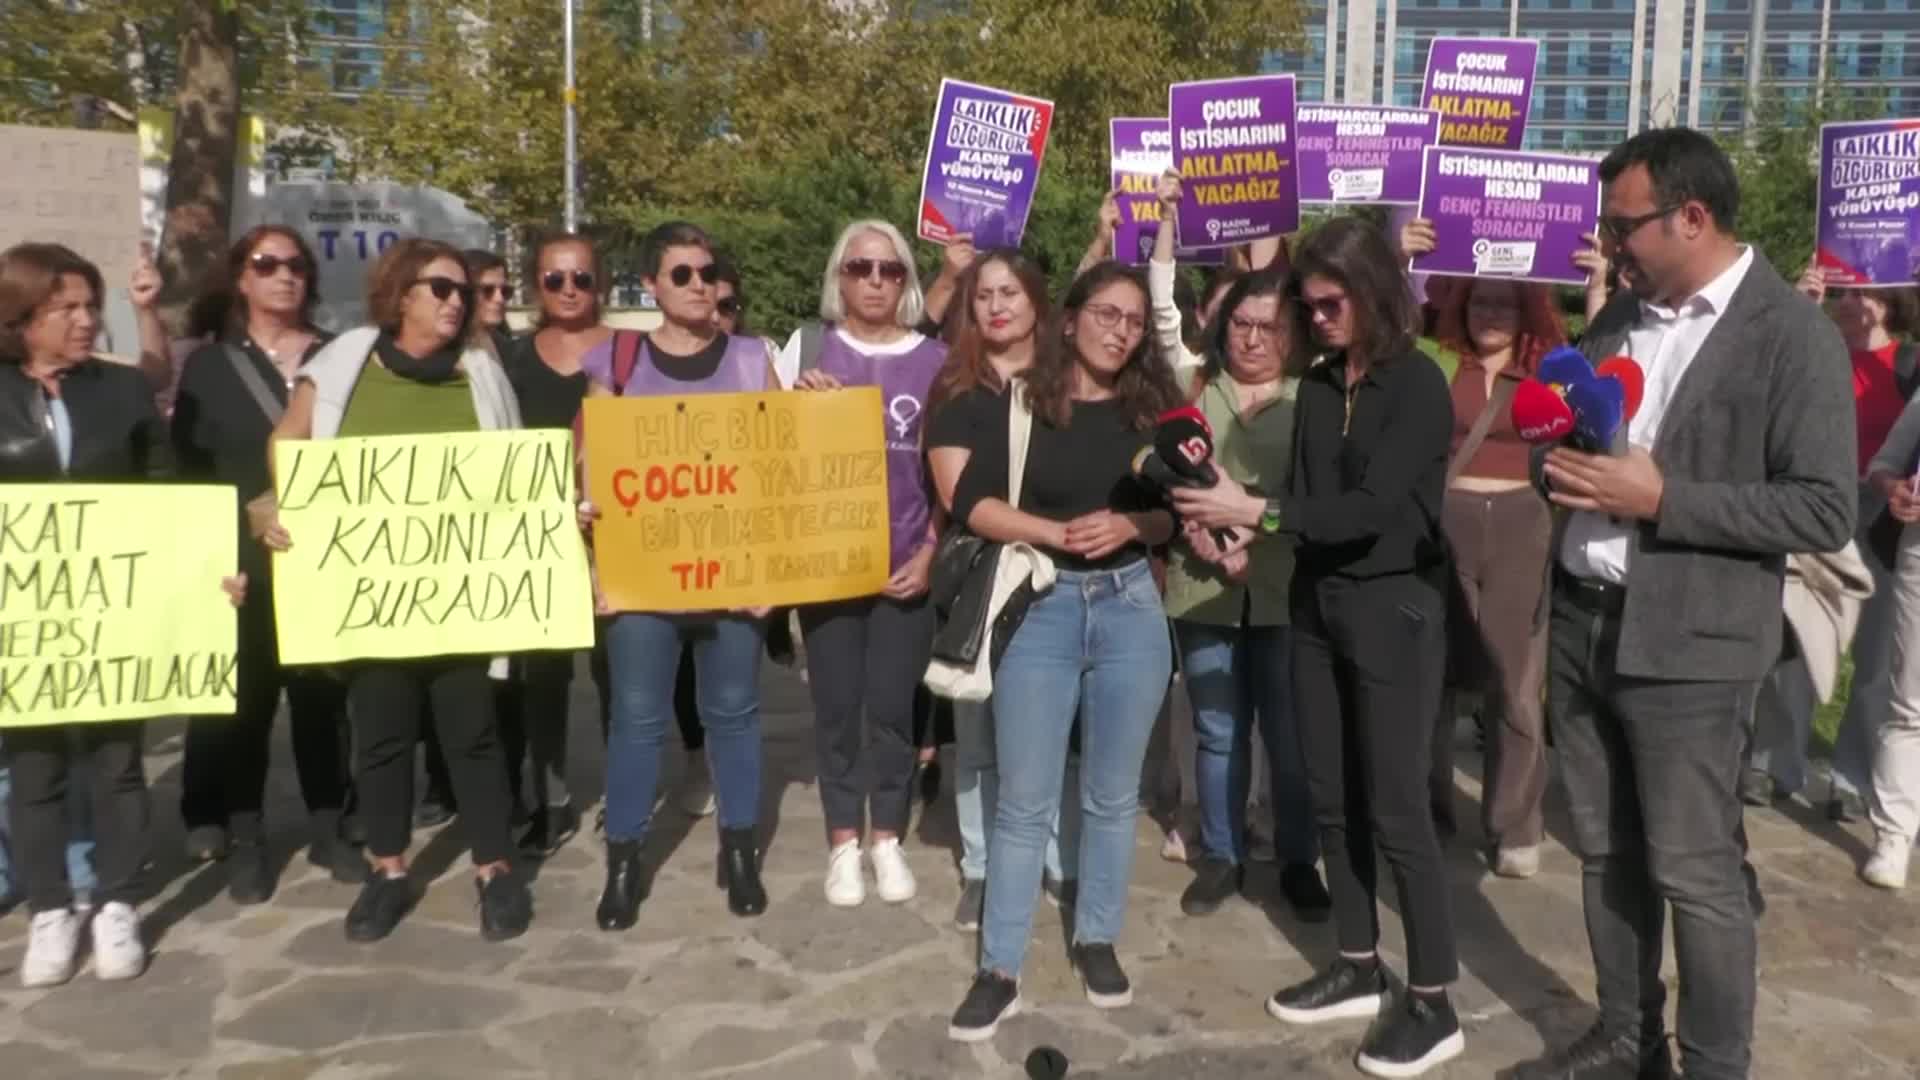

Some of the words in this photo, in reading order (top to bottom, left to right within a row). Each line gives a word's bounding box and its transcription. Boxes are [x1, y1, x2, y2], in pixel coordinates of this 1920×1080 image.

[1456, 53, 1508, 71] ÇOCUK
[1432, 70, 1524, 96] İSTİSMARINI
[1202, 97, 1261, 123] ÇOCUK
[1297, 107, 1429, 125] İSTİSMARCILARDAN
[1141, 131, 1170, 147] ÇOC
[1180, 124, 1286, 151] İSTİSMARINI
[1336, 124, 1386, 137] HESABI
[1297, 136, 1333, 152] GENÇ
[959, 150, 1010, 167] KADIN
[1181, 150, 1290, 179] AKLATMA-
[1326, 151, 1389, 167] SORACAK
[1439, 153, 1589, 185] İSTİSMARCILARDAN
[941, 162, 1023, 186] YÜRÜYÜŞÜ
[1120, 175, 1155, 193] AKL
[1193, 176, 1280, 206] YACAĞIZ
[1485, 179, 1541, 201] HESABI
[1845, 182, 1901, 200] KADIN
[1130, 201, 1161, 222] YAC
[1440, 196, 1482, 217] GENÇ
[1485, 198, 1583, 223] FEMİNİSTLER
[1829, 193, 1919, 218] YÜRÜYÜŞÜ
[1472, 219, 1545, 240] SORACAK
[727, 400, 800, 452] BİR
[612, 463, 739, 517] ÇOCUK
[0, 499, 99, 554] KAT
[318, 510, 564, 571] KADINLAR
[0, 551, 148, 610] MAAT
[335, 567, 553, 638] BURADA!
